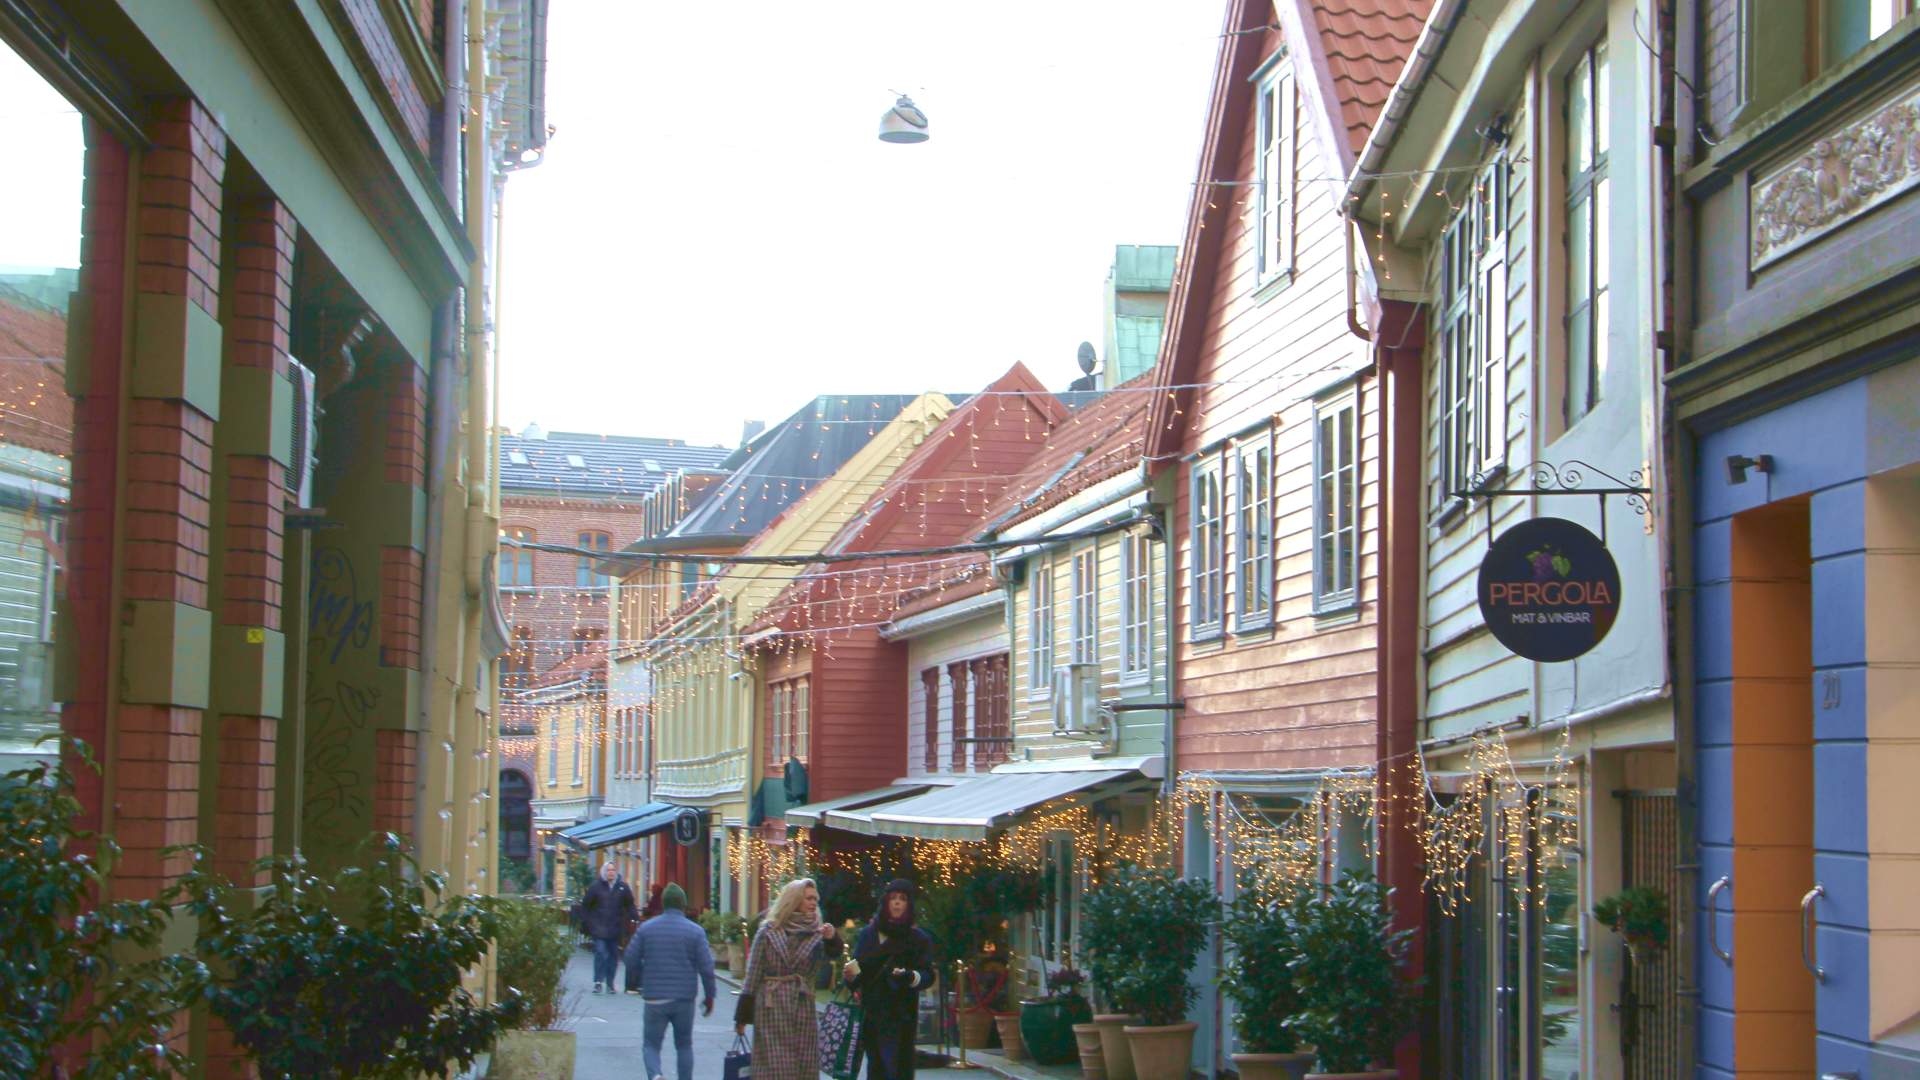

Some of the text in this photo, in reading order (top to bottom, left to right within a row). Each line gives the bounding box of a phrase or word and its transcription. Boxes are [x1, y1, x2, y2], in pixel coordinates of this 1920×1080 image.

[1490, 581, 1612, 605] PERGOLA
[1512, 611, 1592, 624] MAT & VINBAR
